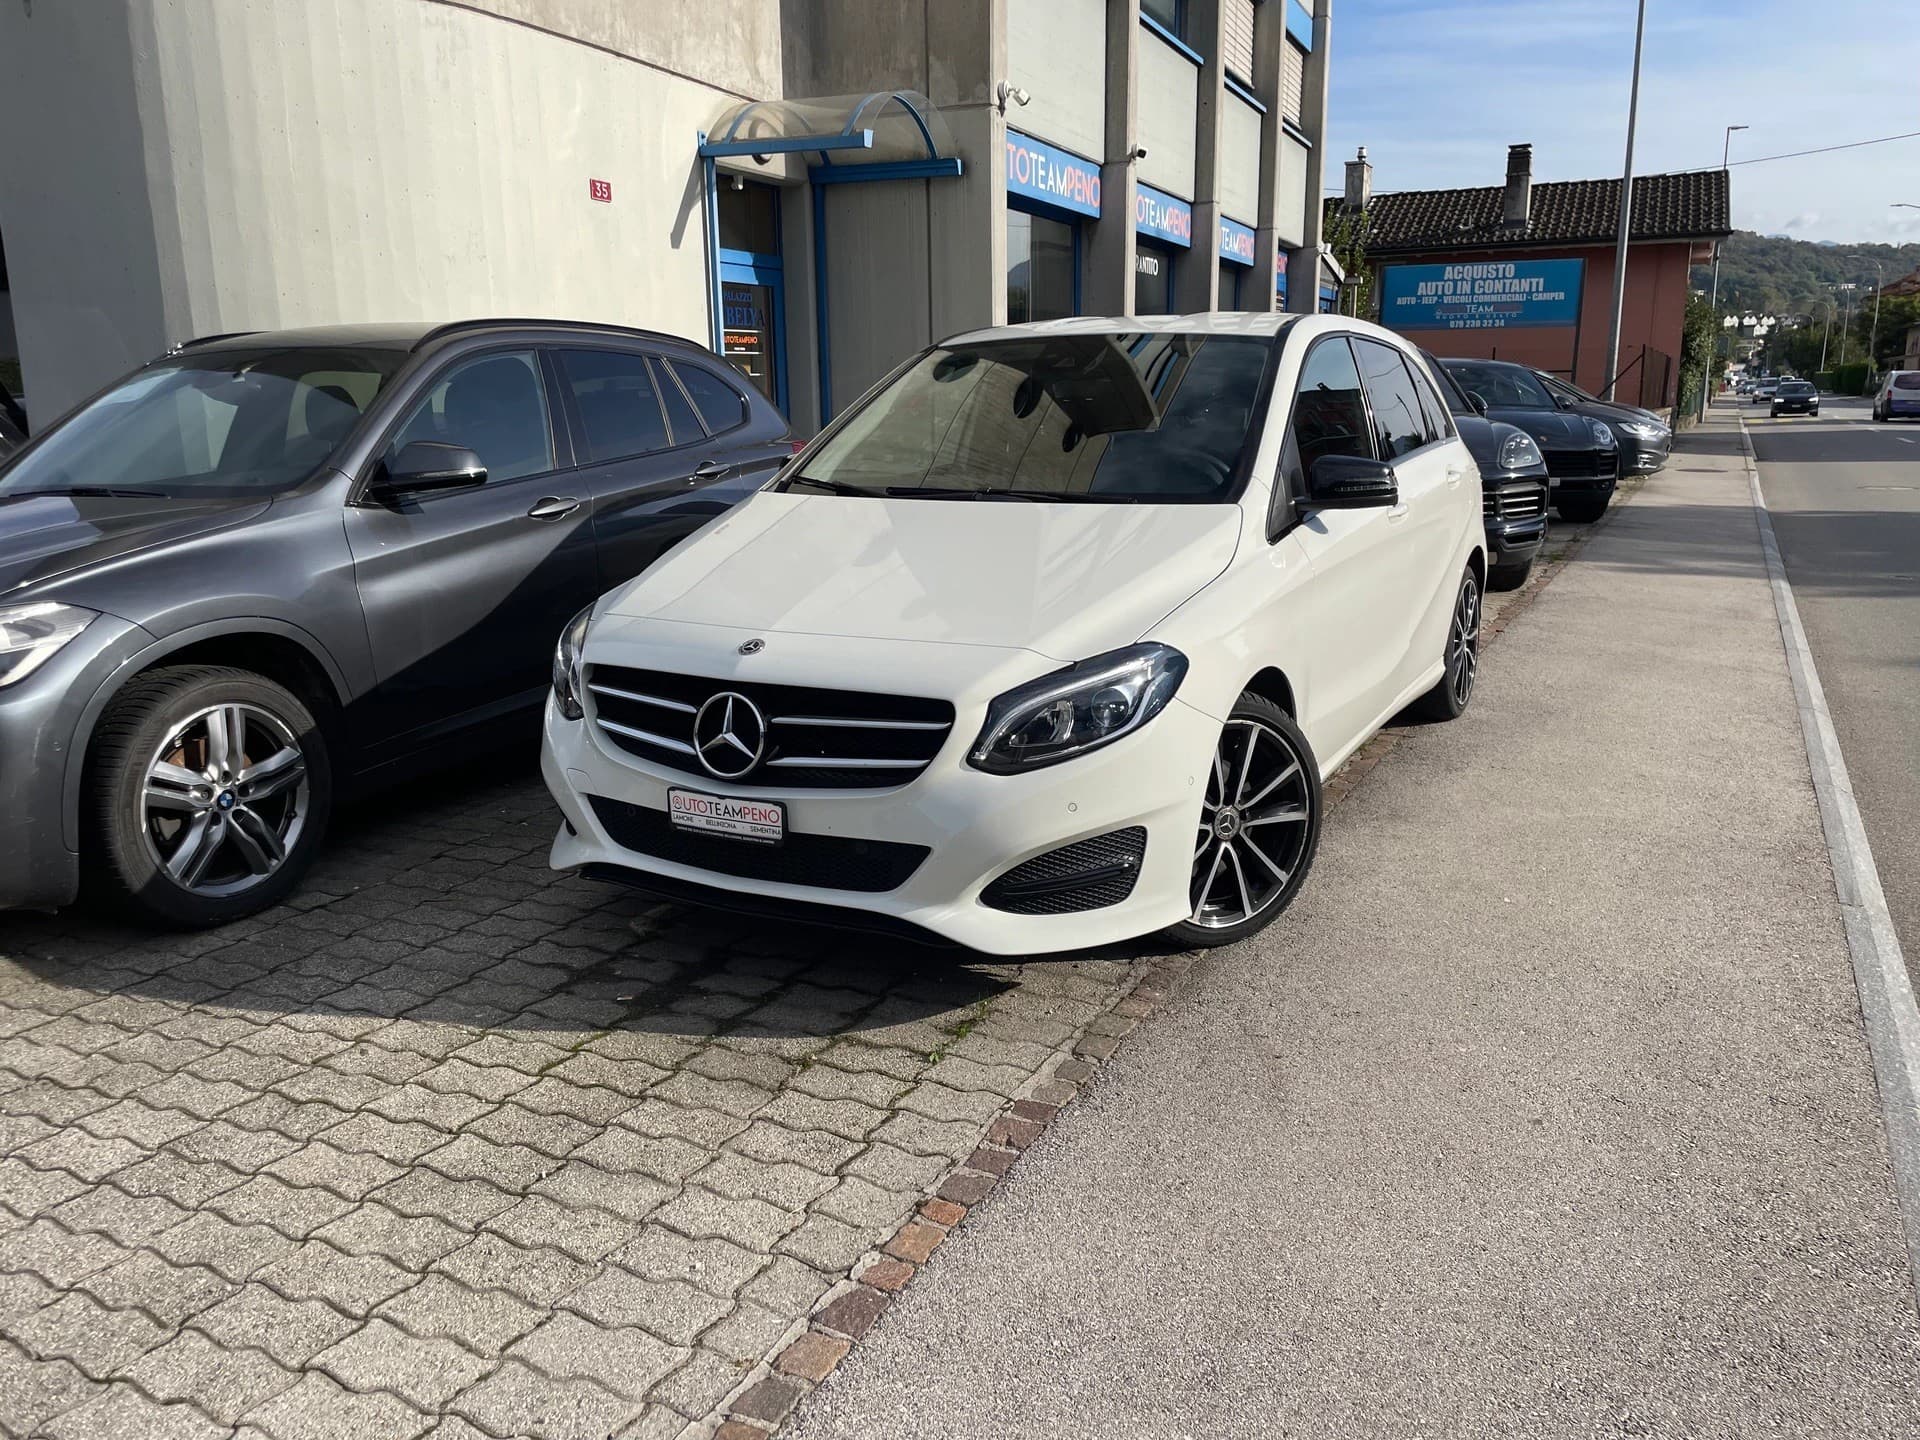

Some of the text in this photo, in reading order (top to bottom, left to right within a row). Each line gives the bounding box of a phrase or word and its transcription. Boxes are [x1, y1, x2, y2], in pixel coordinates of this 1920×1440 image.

[595, 182, 608, 198] 35
[1444, 264, 1515, 280] ACQUISTO
[1417, 278, 1544, 296] AUTO IN CONTANTI
[1396, 296, 1417, 305] AUTO
[1421, 296, 1438, 304] JEEP
[1443, 295, 1472, 304] VEICOLI
[1473, 293, 1526, 303] COMMERCIALI
[1532, 291, 1565, 301] CAMPER
[1465, 304, 1494, 313] TEAM
[673, 813, 694, 824] LAMONE
[750, 825, 781, 837] SEMENTINA
